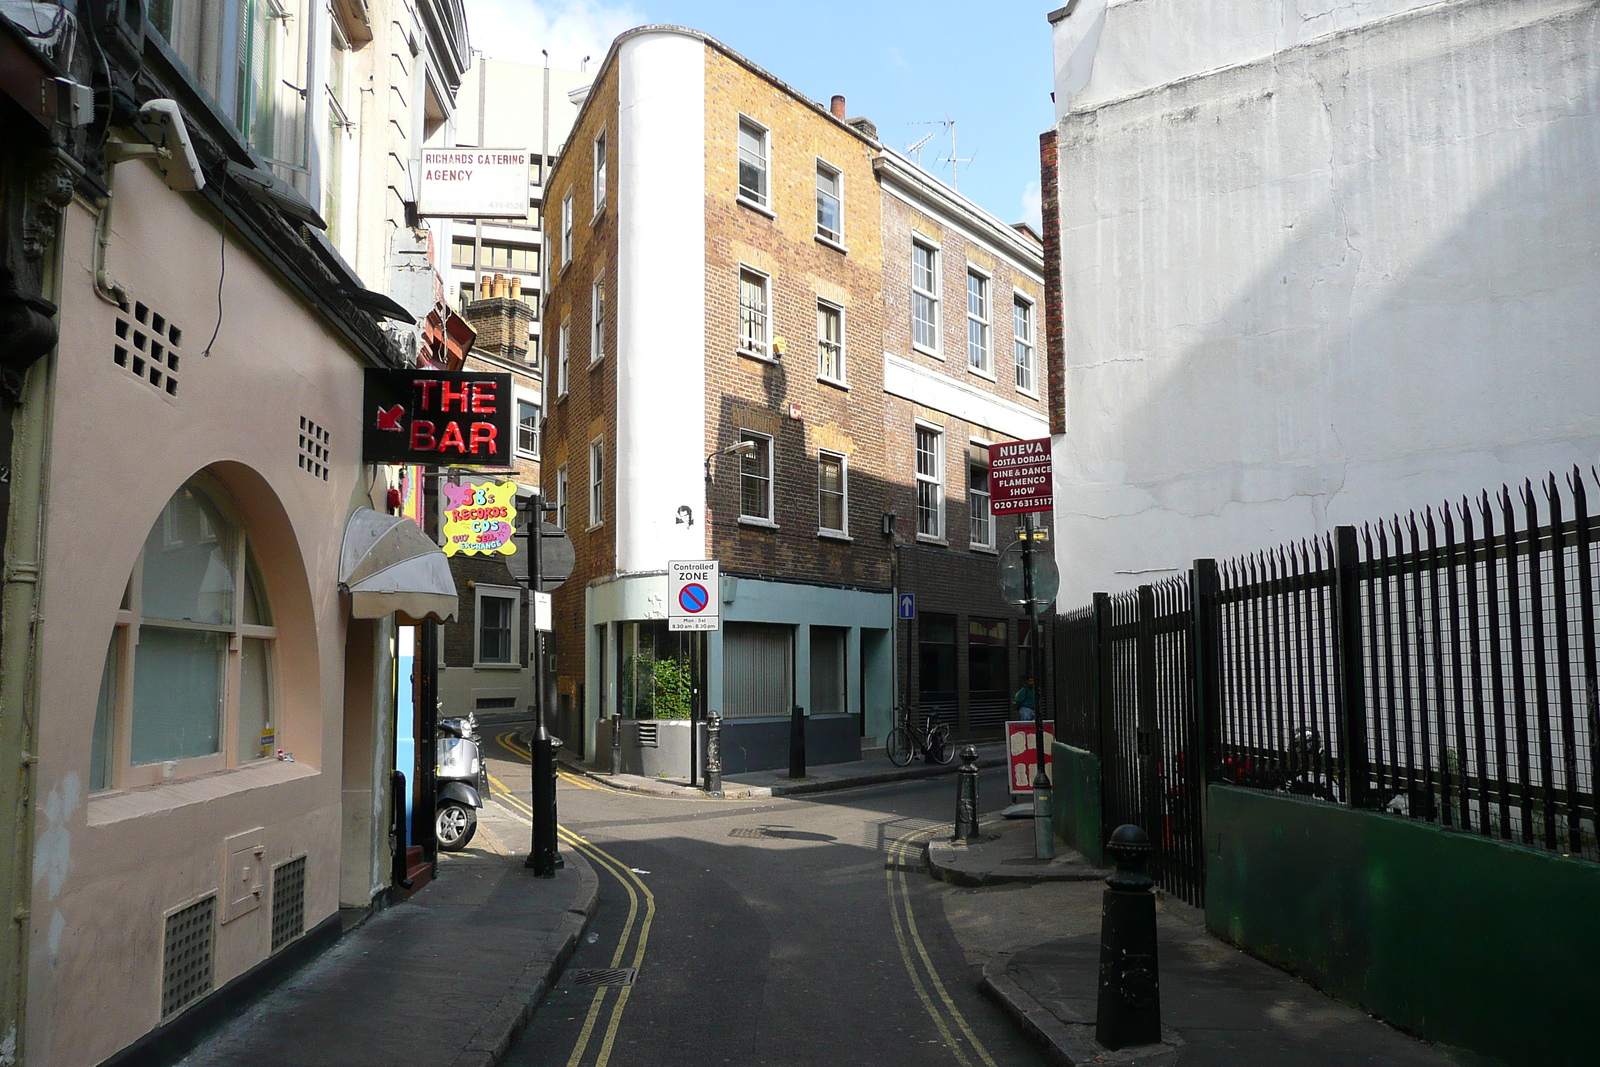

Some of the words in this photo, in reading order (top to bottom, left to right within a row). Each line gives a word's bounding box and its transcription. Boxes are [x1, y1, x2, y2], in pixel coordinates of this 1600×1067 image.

[425, 154, 474, 164] RICHARDS
[477, 154, 525, 165] CATERING
[425, 169, 473, 181] AGENCY
[488, 201, 504, 209] 439
[504, 201, 525, 210] 4526
[413, 379, 498, 414] THE
[410, 420, 498, 455] BAR
[1000, 442, 1044, 457] NUEVA
[992, 457, 1017, 467] COSTA
[1017, 454, 1051, 464] DORADA
[993, 469, 1013, 479] DINE
[1014, 468, 1021, 476] &
[1021, 466, 1052, 476] DANCE
[999, 476, 1046, 487] FLAMENCO
[462, 487, 495, 507] JB's
[1010, 486, 1035, 496] SHOW
[994, 501, 1012, 509] 020
[1012, 499, 1033, 508] 7631
[1034, 497, 1053, 506] 5117
[452, 506, 508, 523] RECORDS
[471, 519, 500, 533] CDS
[452, 534, 469, 543] BUY
[475, 534, 497, 543] SELL
[459, 540, 502, 550] EXCHANGE
[673, 563, 714, 571] Controlled
[679, 572, 709, 581] ZONE
